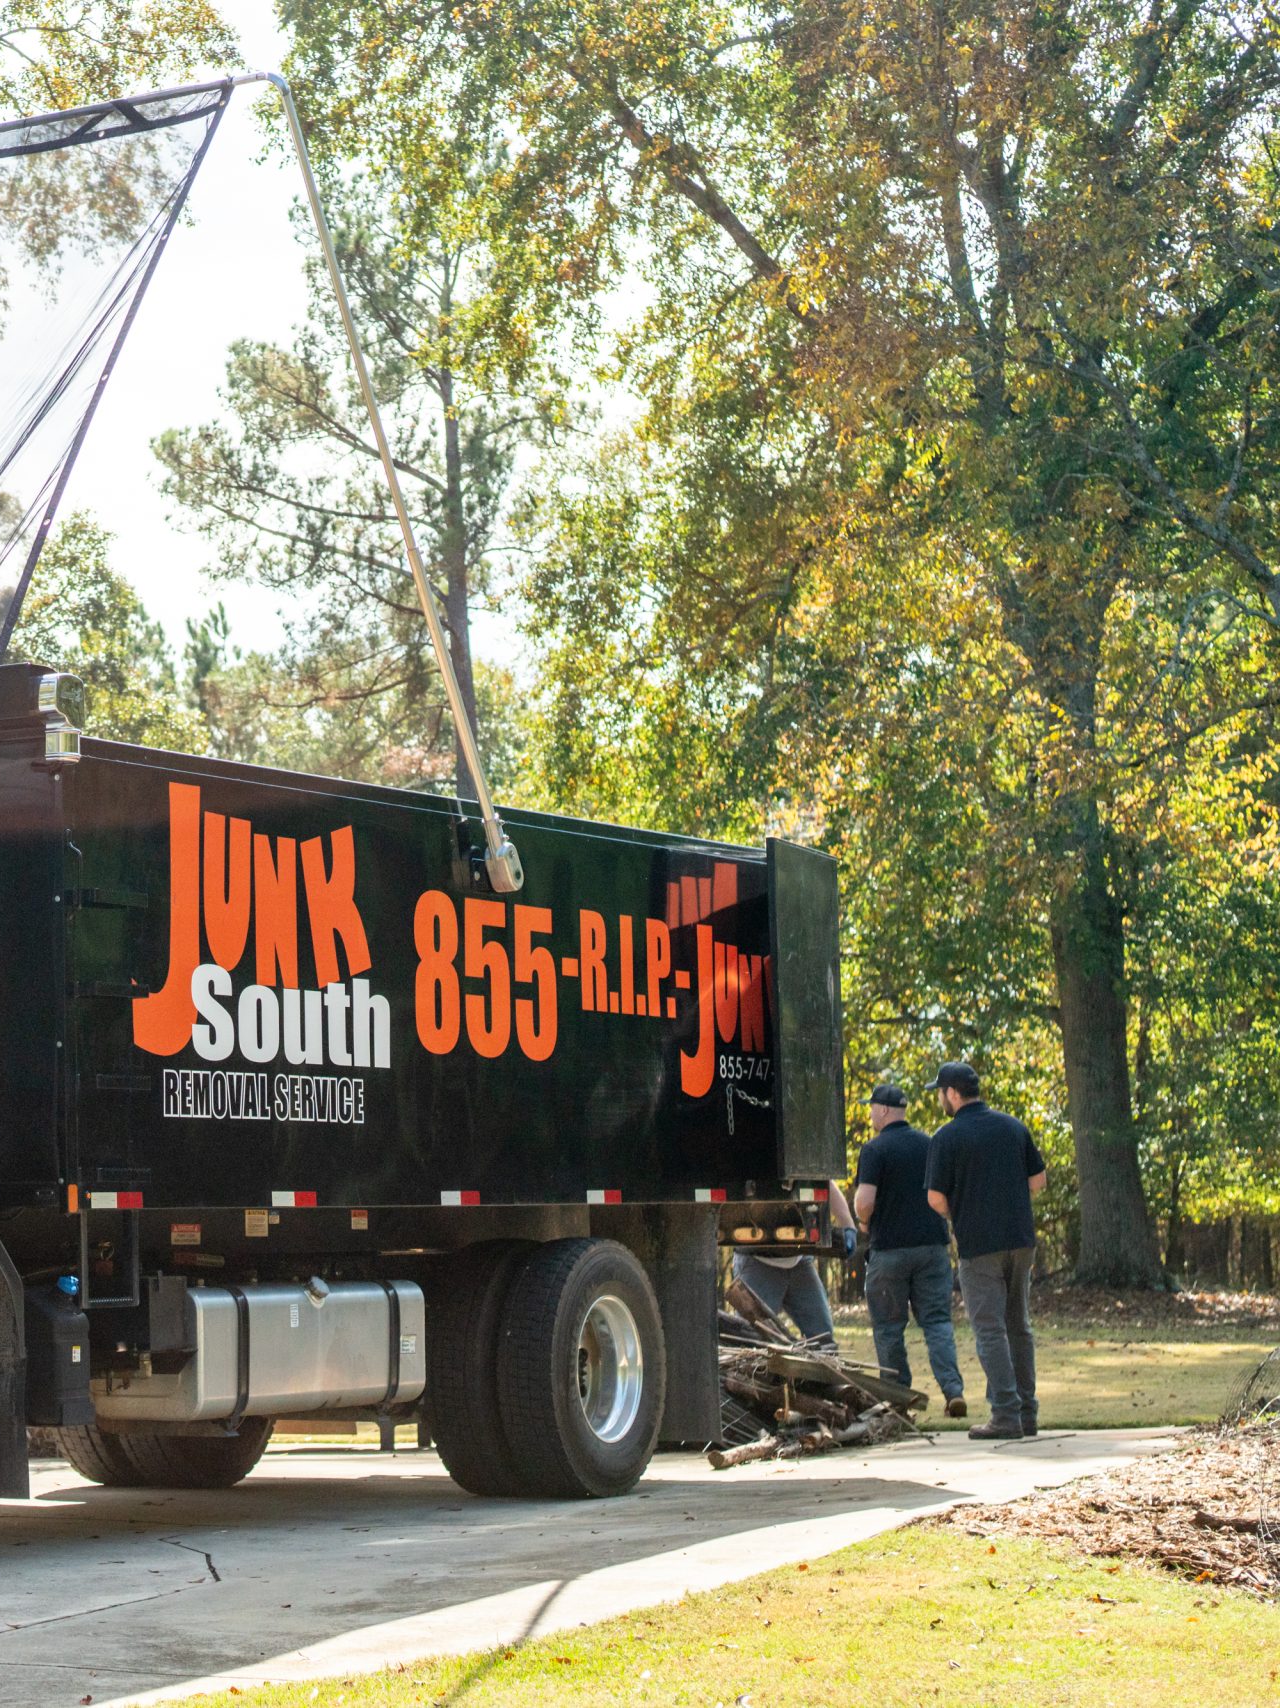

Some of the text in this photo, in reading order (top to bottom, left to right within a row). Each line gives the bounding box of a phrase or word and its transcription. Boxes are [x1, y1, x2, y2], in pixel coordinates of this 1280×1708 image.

[131, 781, 372, 1057] JUNK
[191, 963, 391, 1069] South
[414, 889, 771, 1098] 855-R.I.P.-JUN
[163, 1069, 365, 1124] REMOVAL SERVICE
[719, 1054, 775, 1081] 855-747-
